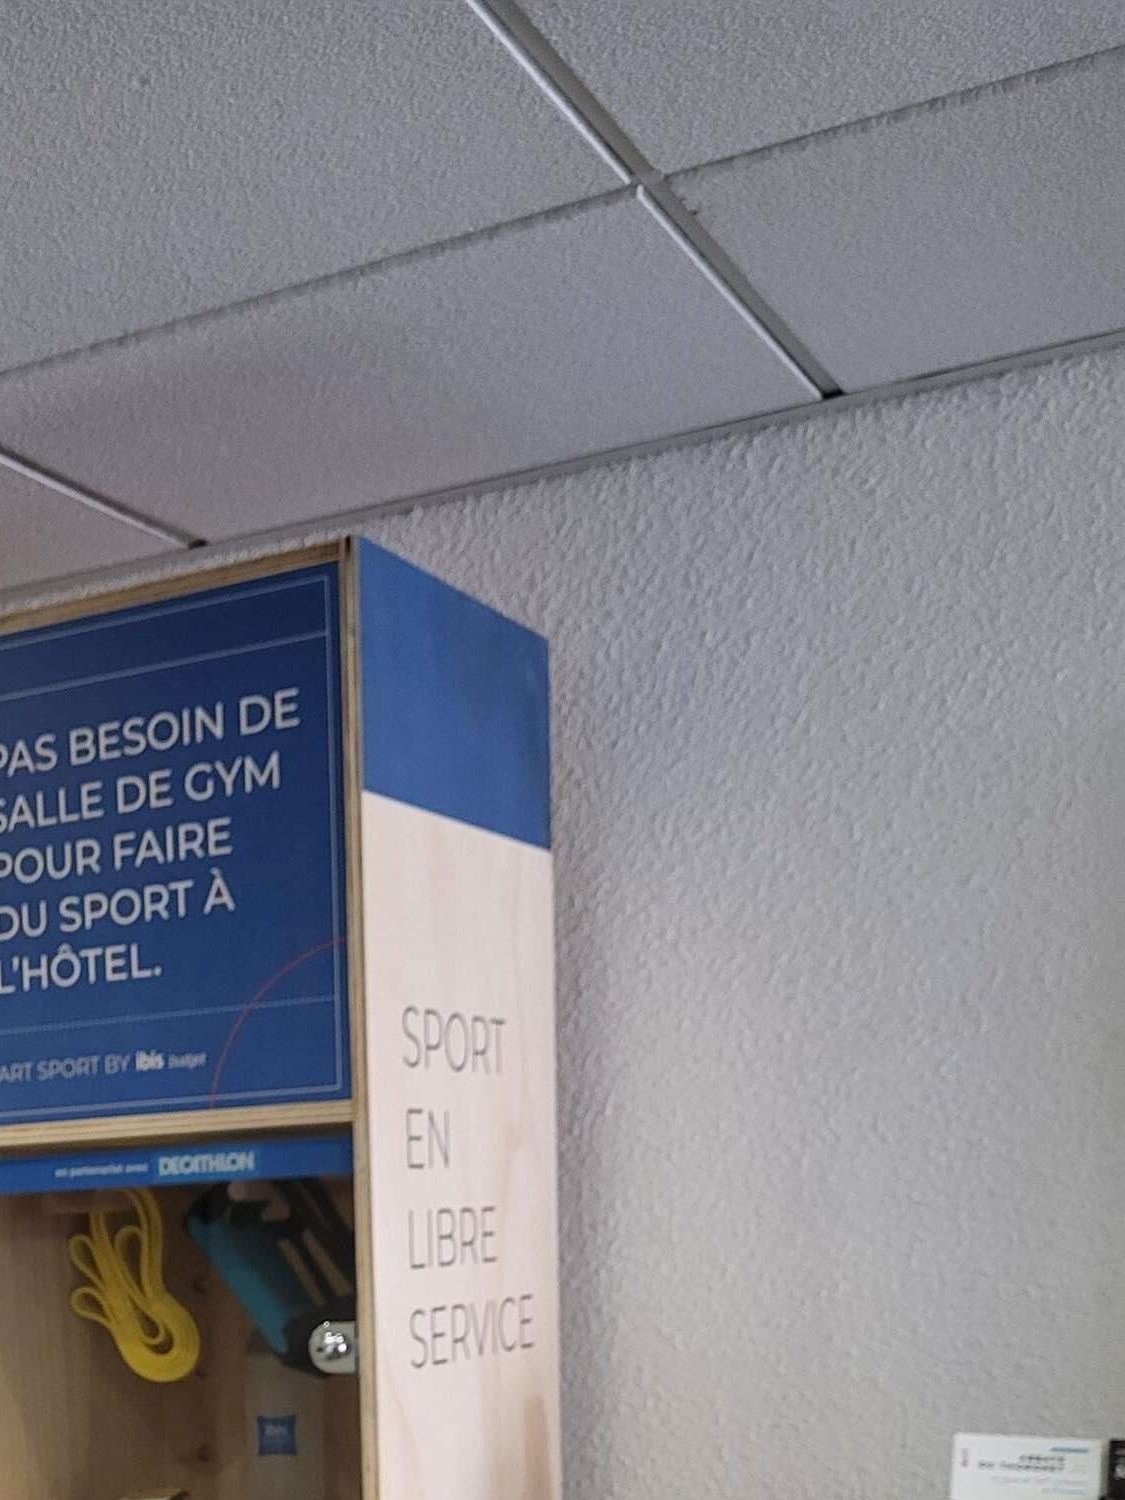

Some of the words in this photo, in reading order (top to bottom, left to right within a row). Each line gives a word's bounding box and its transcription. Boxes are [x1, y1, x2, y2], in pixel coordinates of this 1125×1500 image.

[69, 702, 224, 766] BESOIN
[238, 687, 300, 736] DE
[116, 773, 172, 814] DE
[184, 750, 280, 801] GYM
[112, 817, 233, 871] FAIRE
[58, 879, 194, 934] SPORT
[203, 866, 235, 915] À
[36, 1055, 98, 1081] SPORT
[104, 1054, 130, 1075] BY
[136, 1050, 164, 1070] ibis
[401, 1005, 506, 1075] SPORT
[159, 1152, 254, 1177] DECATHLON
[406, 1107, 451, 1170] EN
[408, 1205, 497, 1269] LIBRE
[410, 1293, 535, 1369] SERVICE
